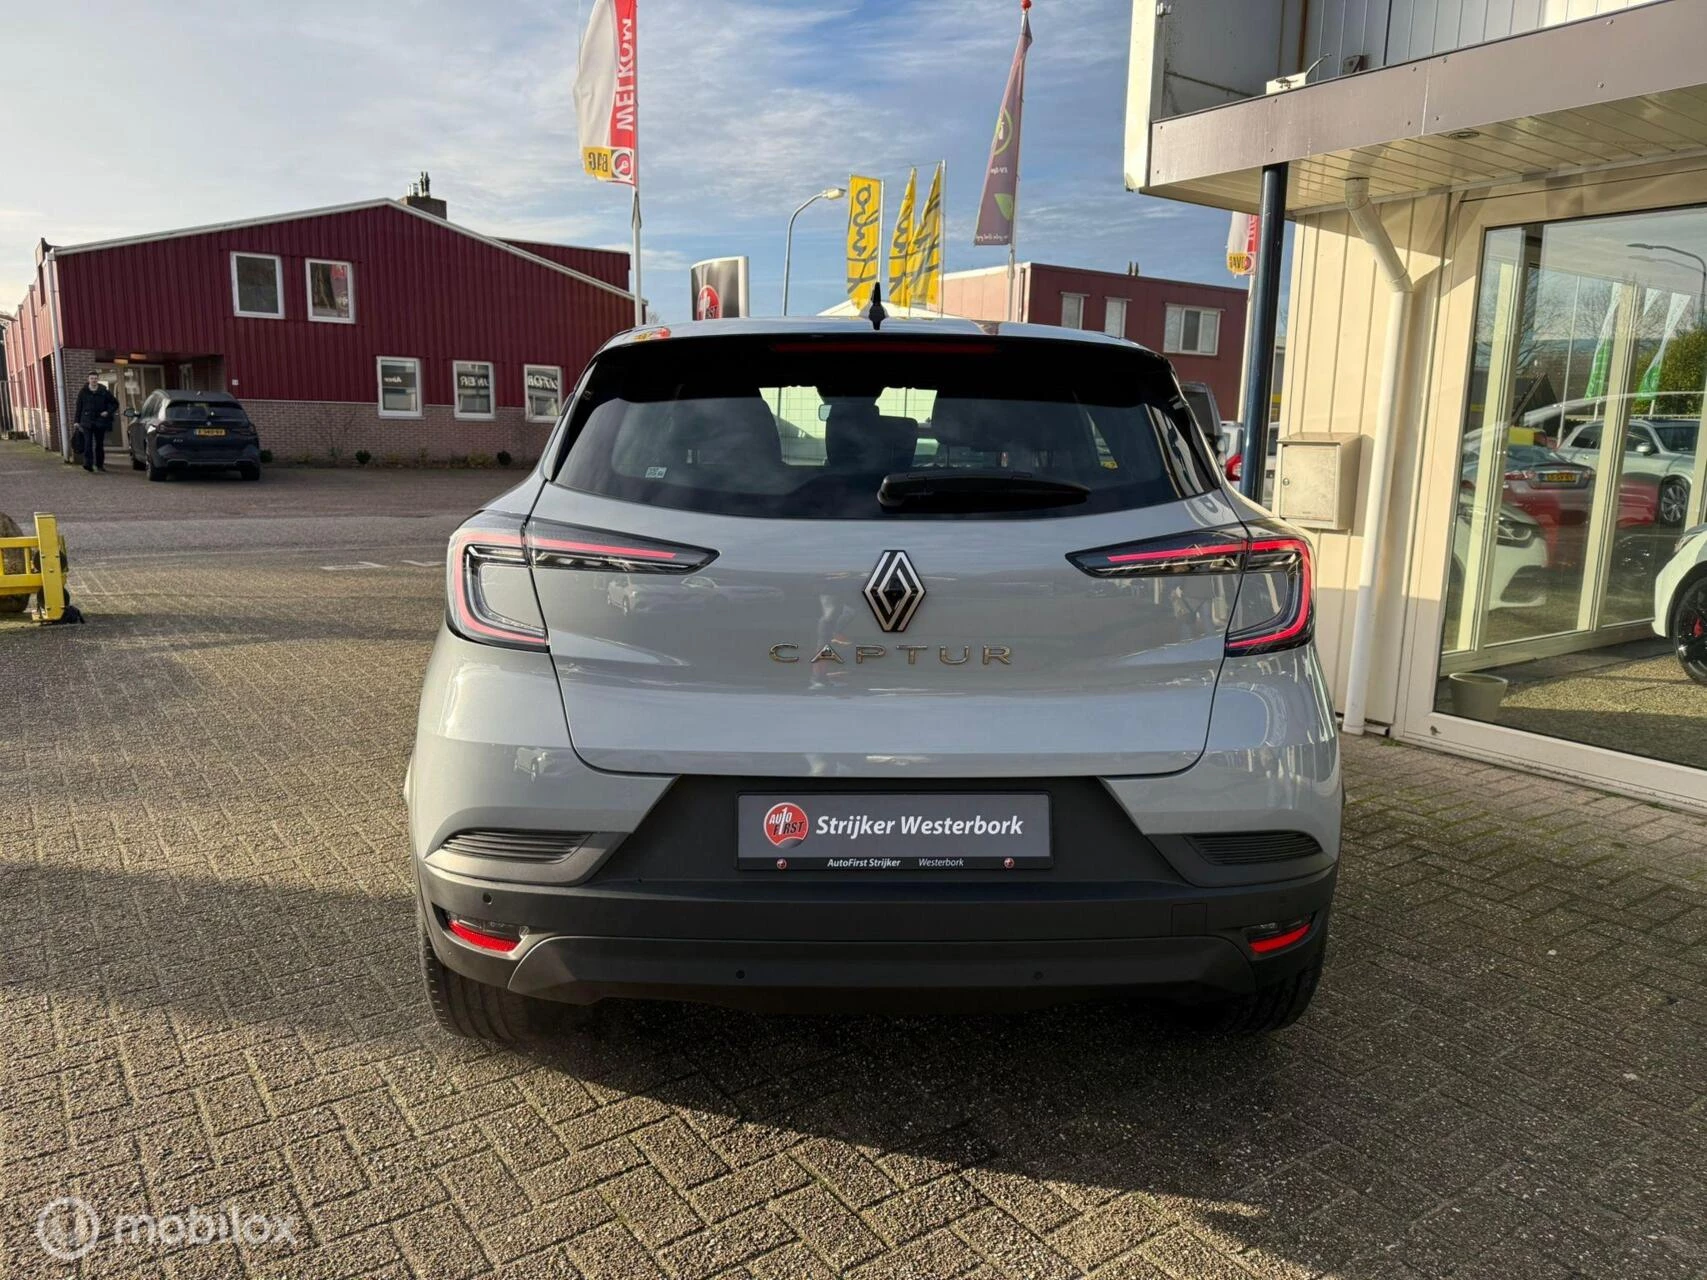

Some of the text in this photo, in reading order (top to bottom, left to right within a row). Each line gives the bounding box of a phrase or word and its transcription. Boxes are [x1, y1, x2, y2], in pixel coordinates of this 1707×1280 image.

[769, 643, 1011, 665] CAPTUR
[816, 815, 1023, 839] Strijker Westerbork
[827, 858, 963, 869] AutoFirst Strijker Westerbork
